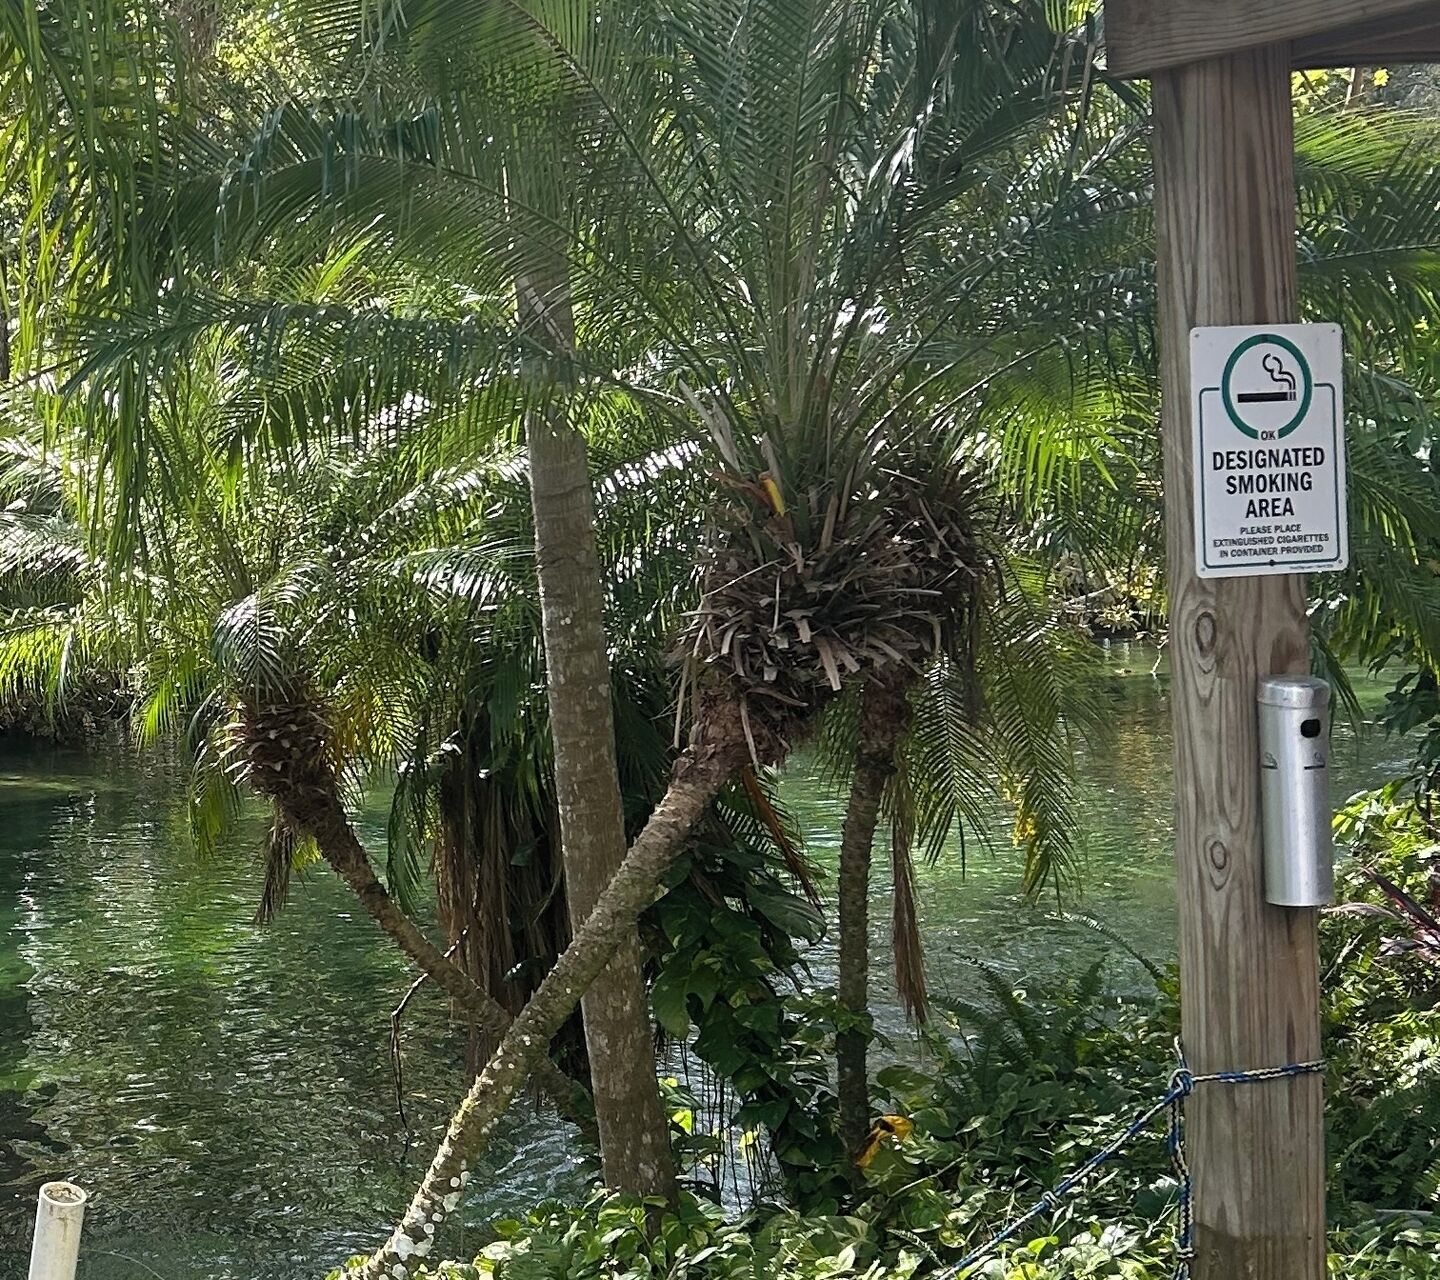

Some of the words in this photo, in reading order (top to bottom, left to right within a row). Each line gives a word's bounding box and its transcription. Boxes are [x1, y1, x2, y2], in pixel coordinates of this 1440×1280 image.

[1260, 430, 1276, 440] OK
[1213, 447, 1325, 471] DESIGNATED
[1226, 472, 1312, 495] SMOKING
[1245, 497, 1295, 518] AREA
[1240, 525, 1272, 535] PLEASE
[1274, 524, 1302, 533] PLACE
[1213, 536, 1274, 547] EXTINGUISHED
[1276, 533, 1329, 544] CIGARETTES
[1219, 550, 1229, 558] IN
[1230, 547, 1278, 557] CONTAINER
[1280, 545, 1324, 554] PROVIDED
